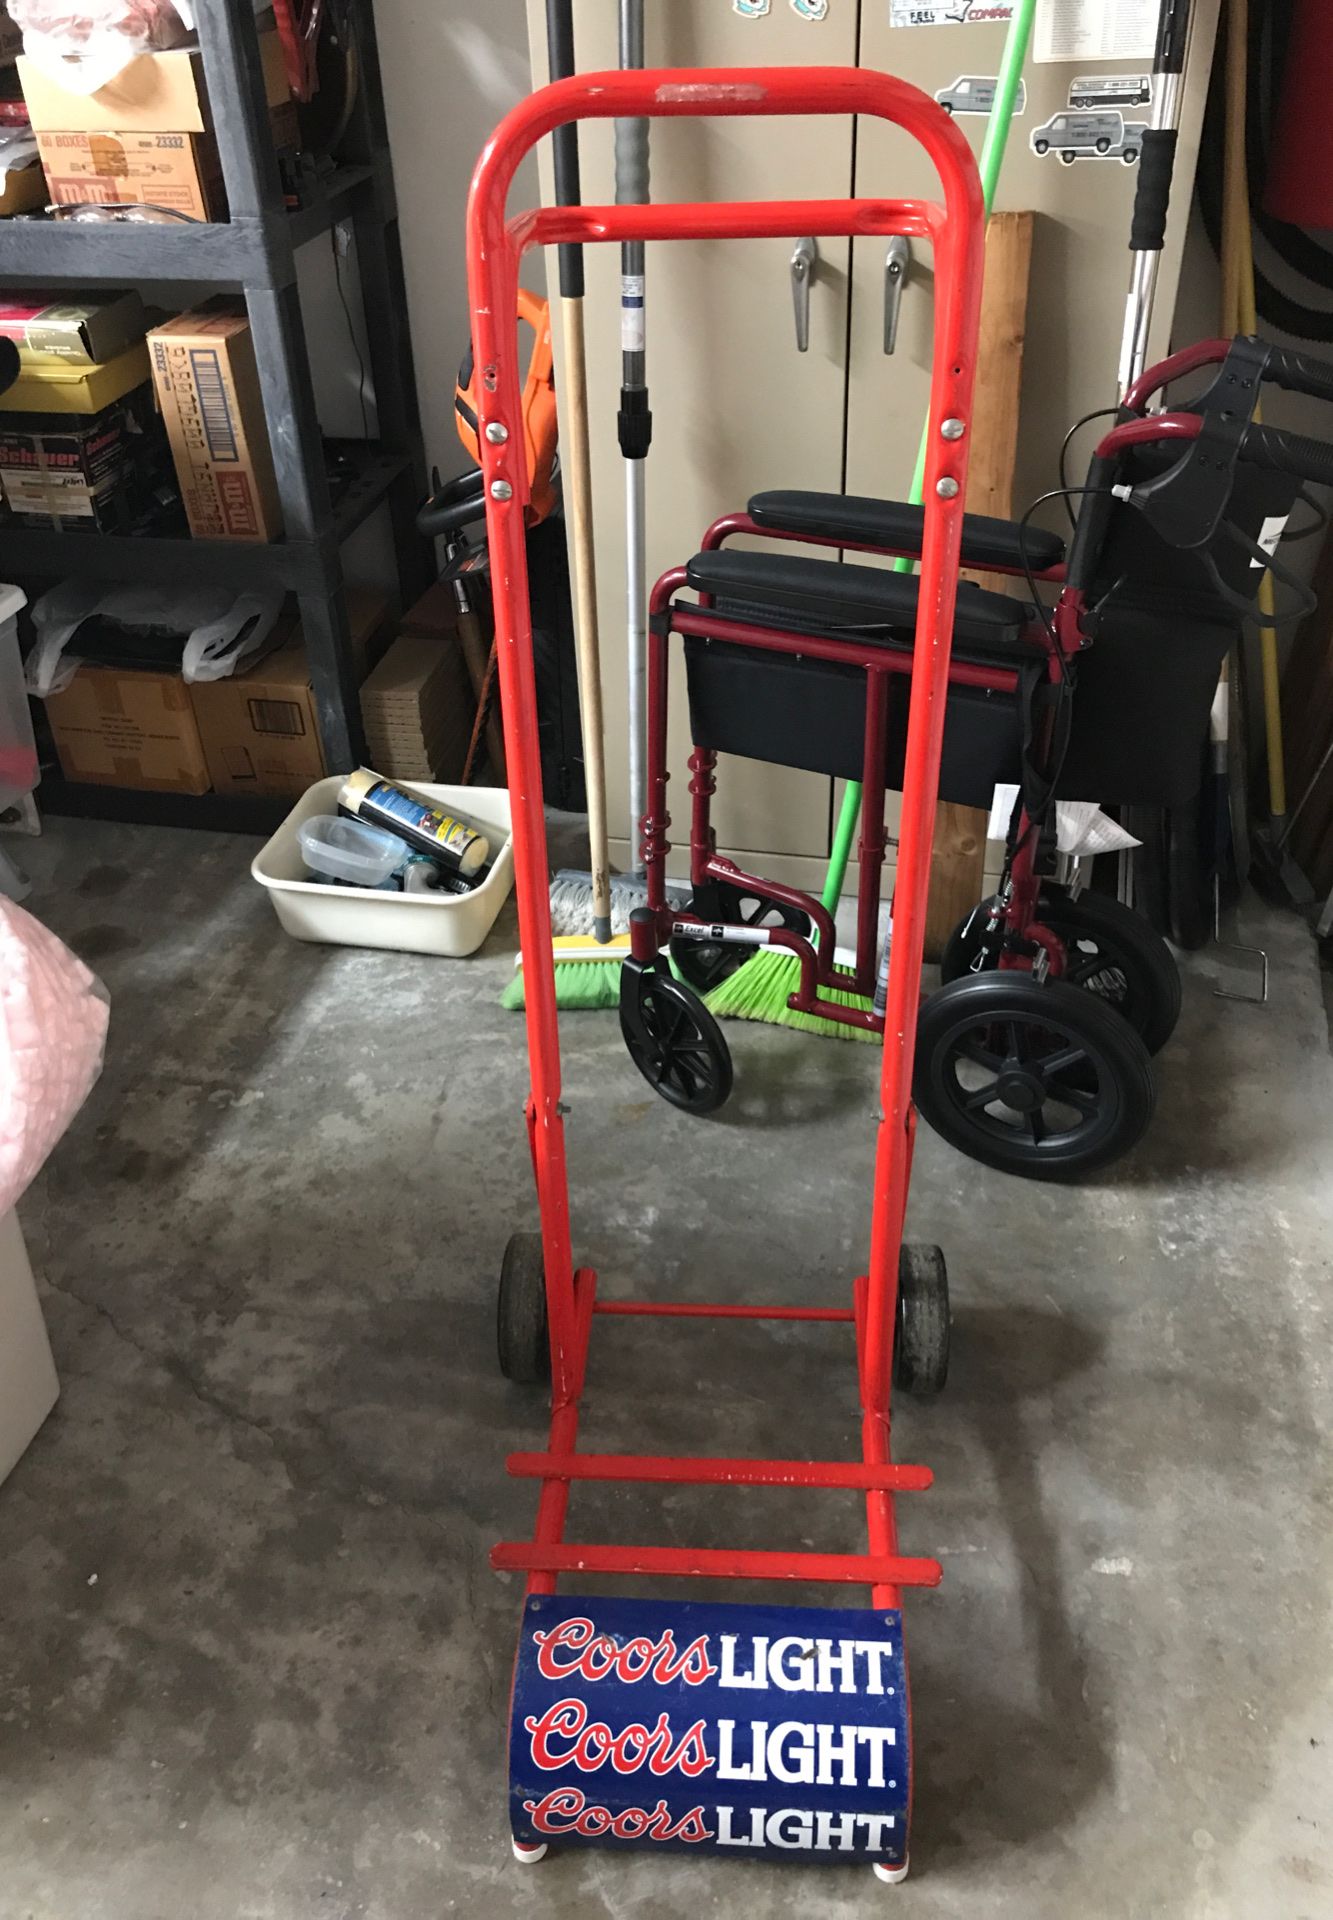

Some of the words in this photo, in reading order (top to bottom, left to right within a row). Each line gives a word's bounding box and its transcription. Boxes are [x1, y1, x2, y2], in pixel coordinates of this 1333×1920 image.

[910, 11, 935, 19] FEEL
[55, 136, 89, 148] BOXES
[156, 136, 184, 148] 23332
[153, 342, 167, 372] 23332
[0, 446, 80, 467] Schauer
[533, 1617, 717, 1685] Coors
[524, 1698, 715, 1777] Coors
[523, 1787, 715, 1842] Coors
[716, 1805, 895, 1851] LIGHT
